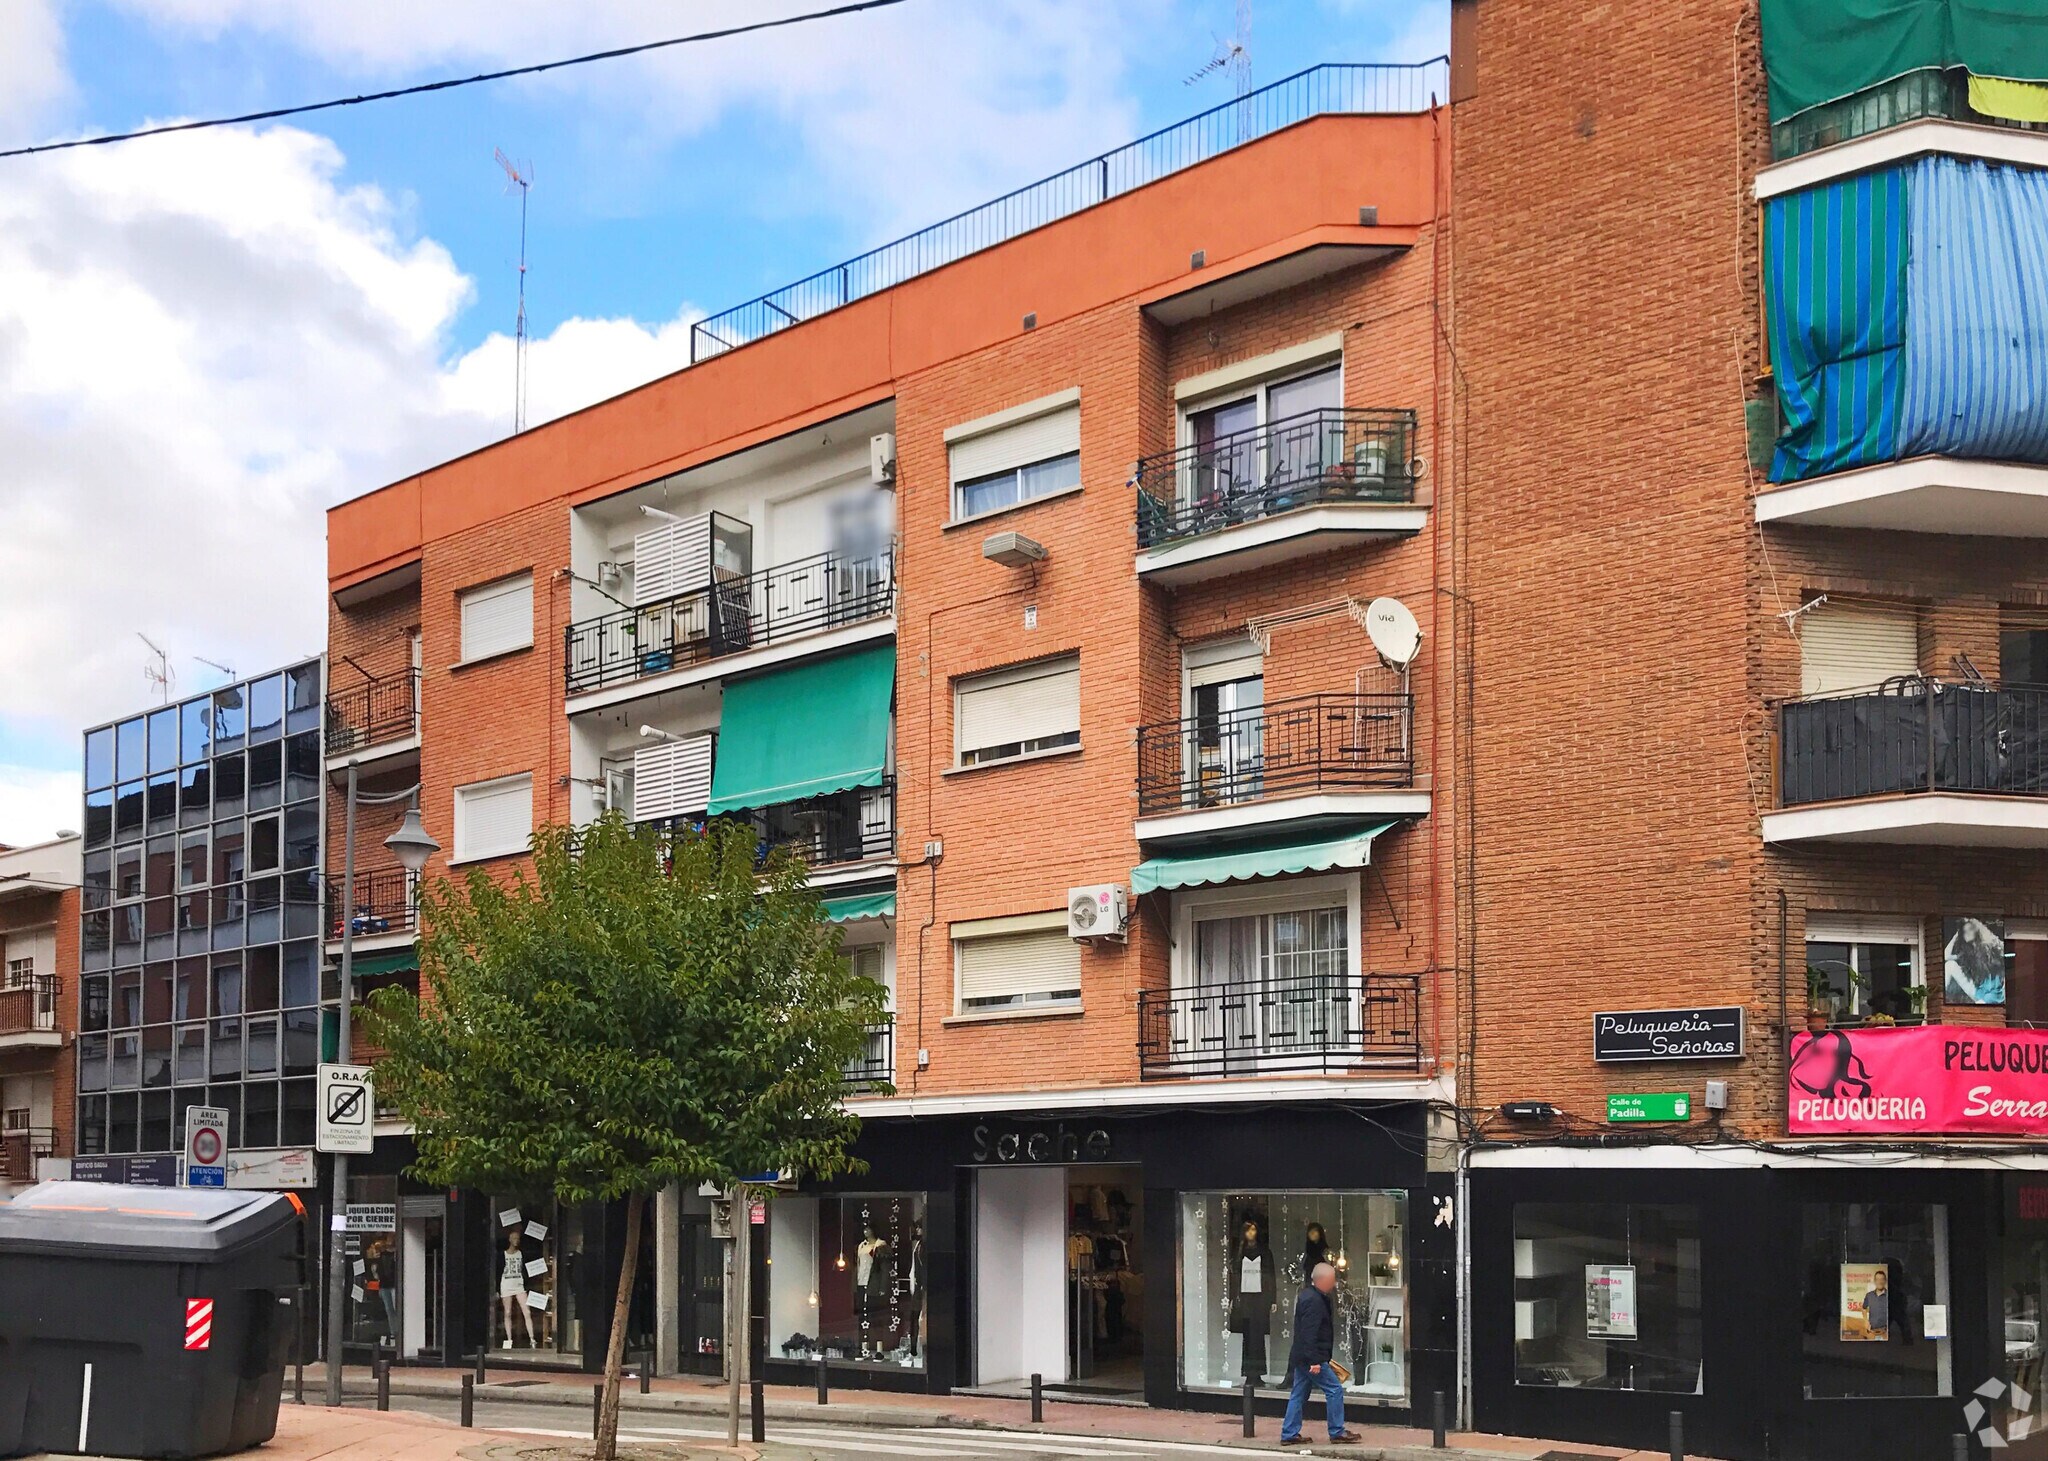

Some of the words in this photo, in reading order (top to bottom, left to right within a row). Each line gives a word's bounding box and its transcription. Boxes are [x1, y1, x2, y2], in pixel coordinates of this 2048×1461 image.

[1600, 1013, 1711, 1040] Peluqueria
[1652, 1037, 1735, 1054] Señoras
[331, 1072, 362, 1082] O.R.A.
[1610, 1098, 1630, 1106] Calle
[1632, 1098, 1642, 1106] de
[1610, 1108, 1646, 1118] Padilla
[1797, 1097, 1926, 1121] PELUQUERIA
[193, 1119, 224, 1127] LIMITADA
[973, 1122, 1111, 1162] Sache
[191, 1167, 223, 1175] ATENCIÓN
[346, 1206, 395, 1214] IQUIDACION
[346, 1215, 363, 1223] POR
[366, 1215, 395, 1223] CIERRE
